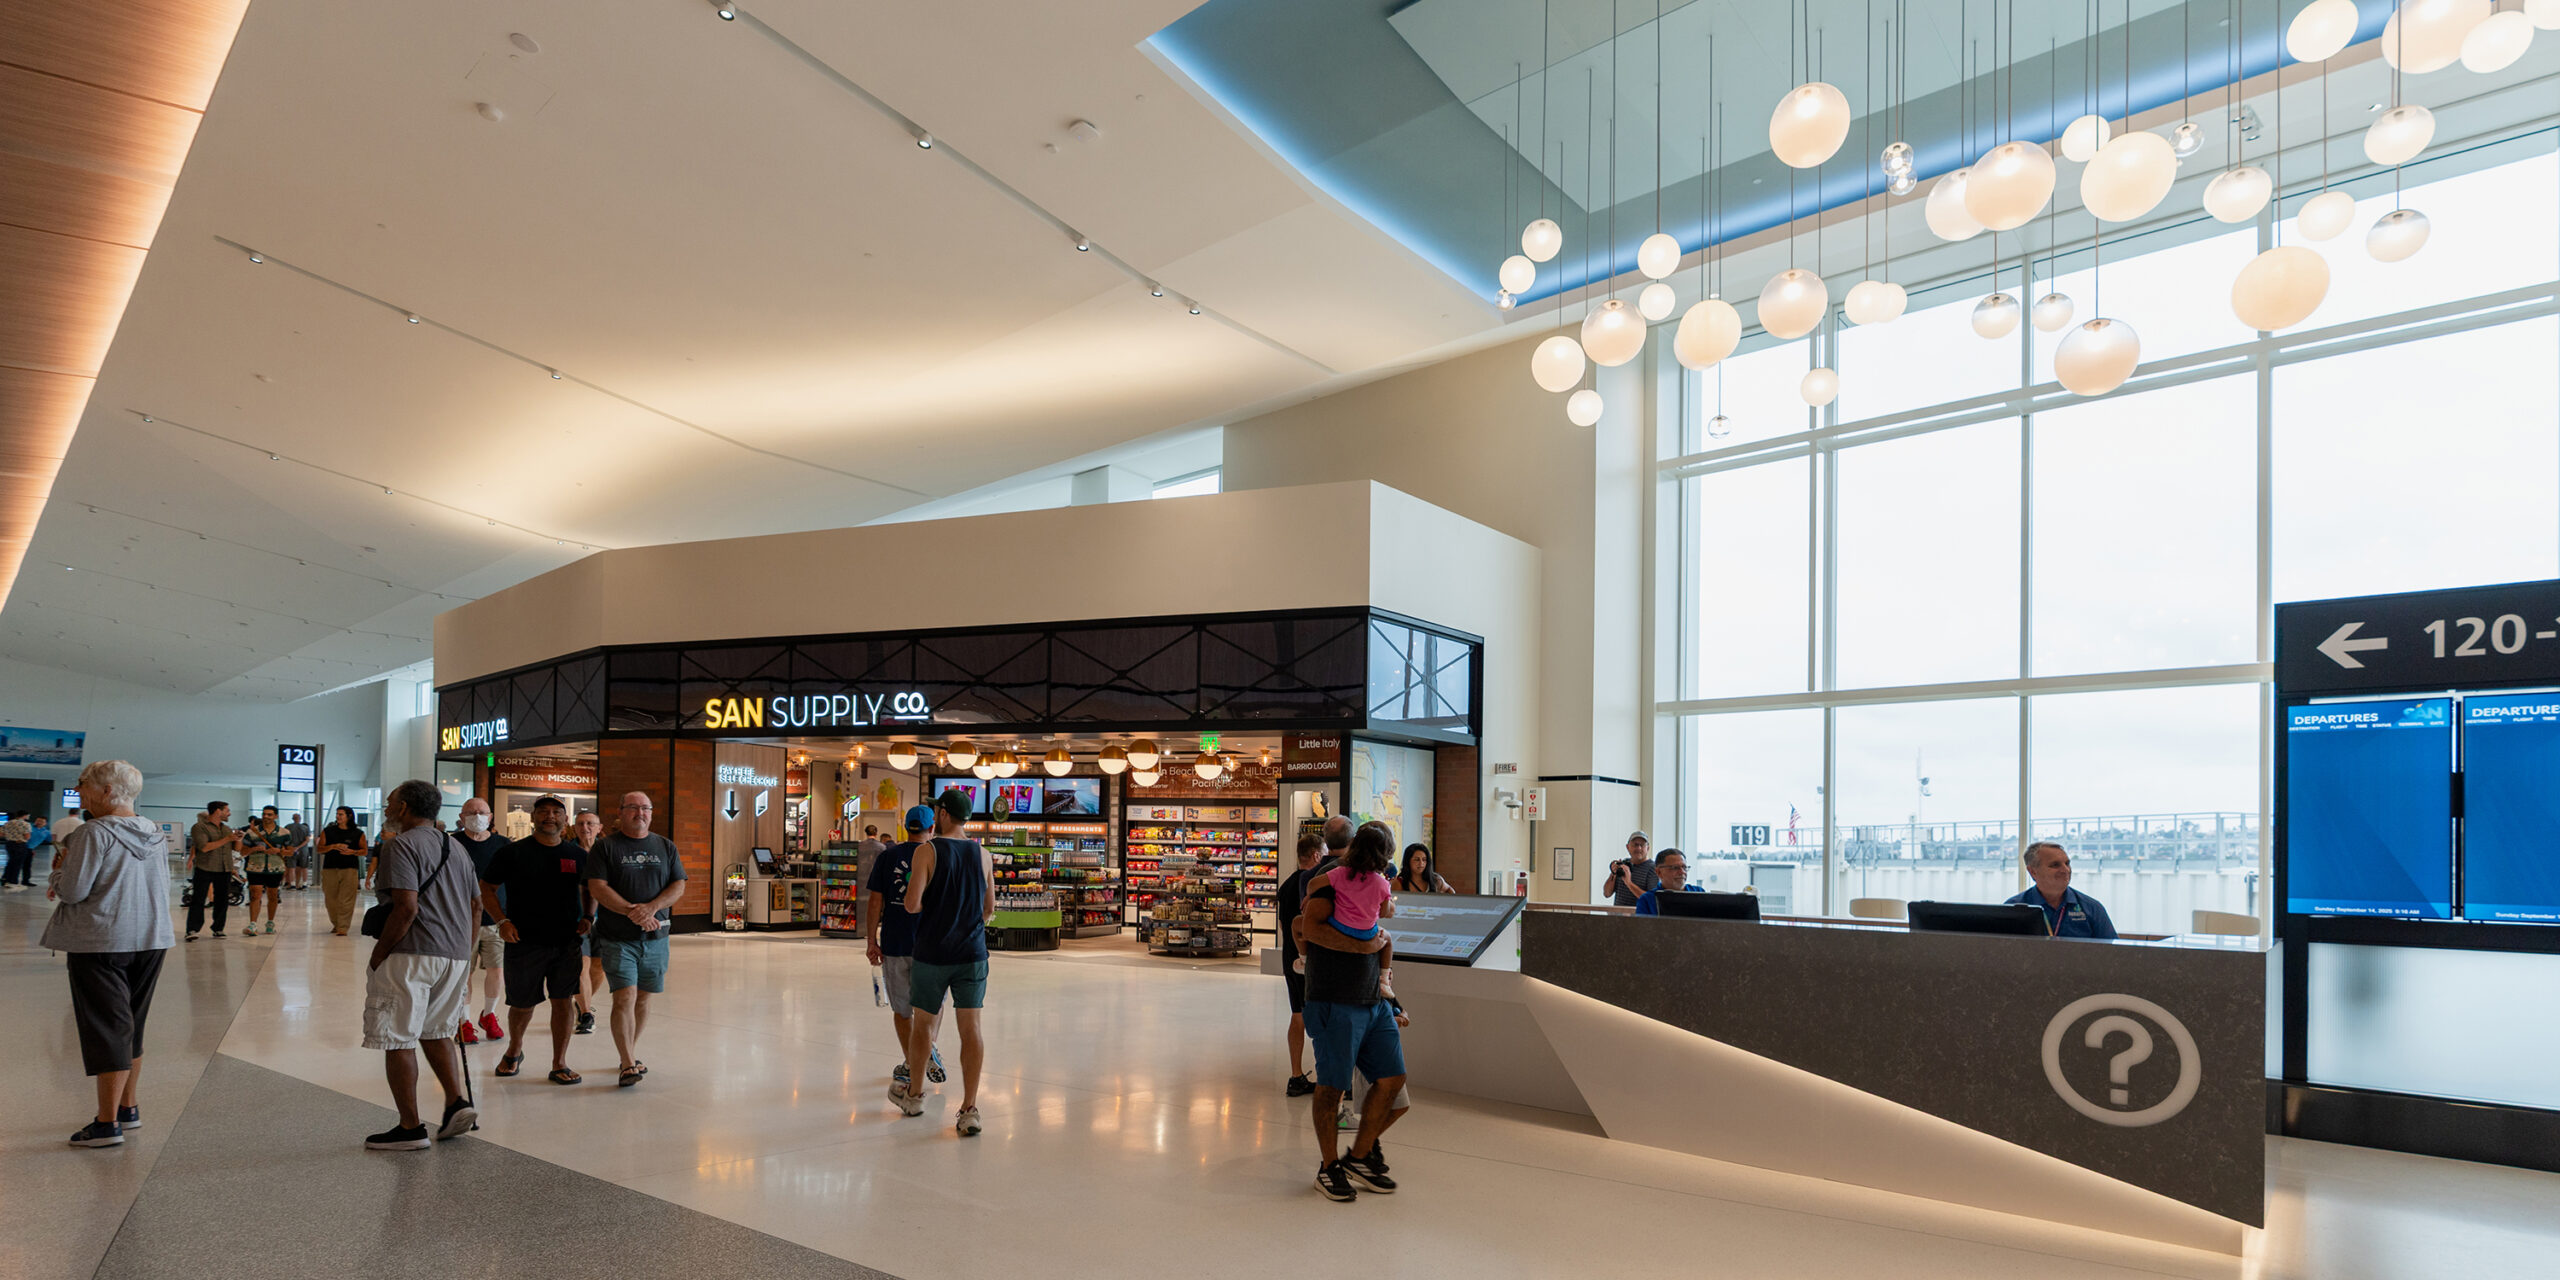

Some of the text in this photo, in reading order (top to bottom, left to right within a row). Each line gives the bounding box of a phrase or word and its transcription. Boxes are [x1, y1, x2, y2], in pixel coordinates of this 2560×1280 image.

[2423, 613, 2560, 658] 120-
[705, 692, 929, 728] SAN SUPPLY CO.
[2472, 704, 2560, 717] DEPARTURE
[2294, 712, 2379, 725] DEPARTURES
[442, 726, 460, 751] SAN
[461, 720, 495, 749] SUPPLY
[1299, 738, 1341, 749] Little Italy
[282, 748, 315, 763] 120
[498, 757, 534, 766] CORTEZ
[535, 760, 553, 768] HILL
[1287, 761, 1337, 771] BARRIO LOGAN
[519, 773, 544, 781] TOWN
[547, 774, 589, 784] MISSION
[739, 775, 778, 787] CHECKOUT
[1192, 778, 1221, 788] Pacific
[1735, 826, 1766, 845] 119
